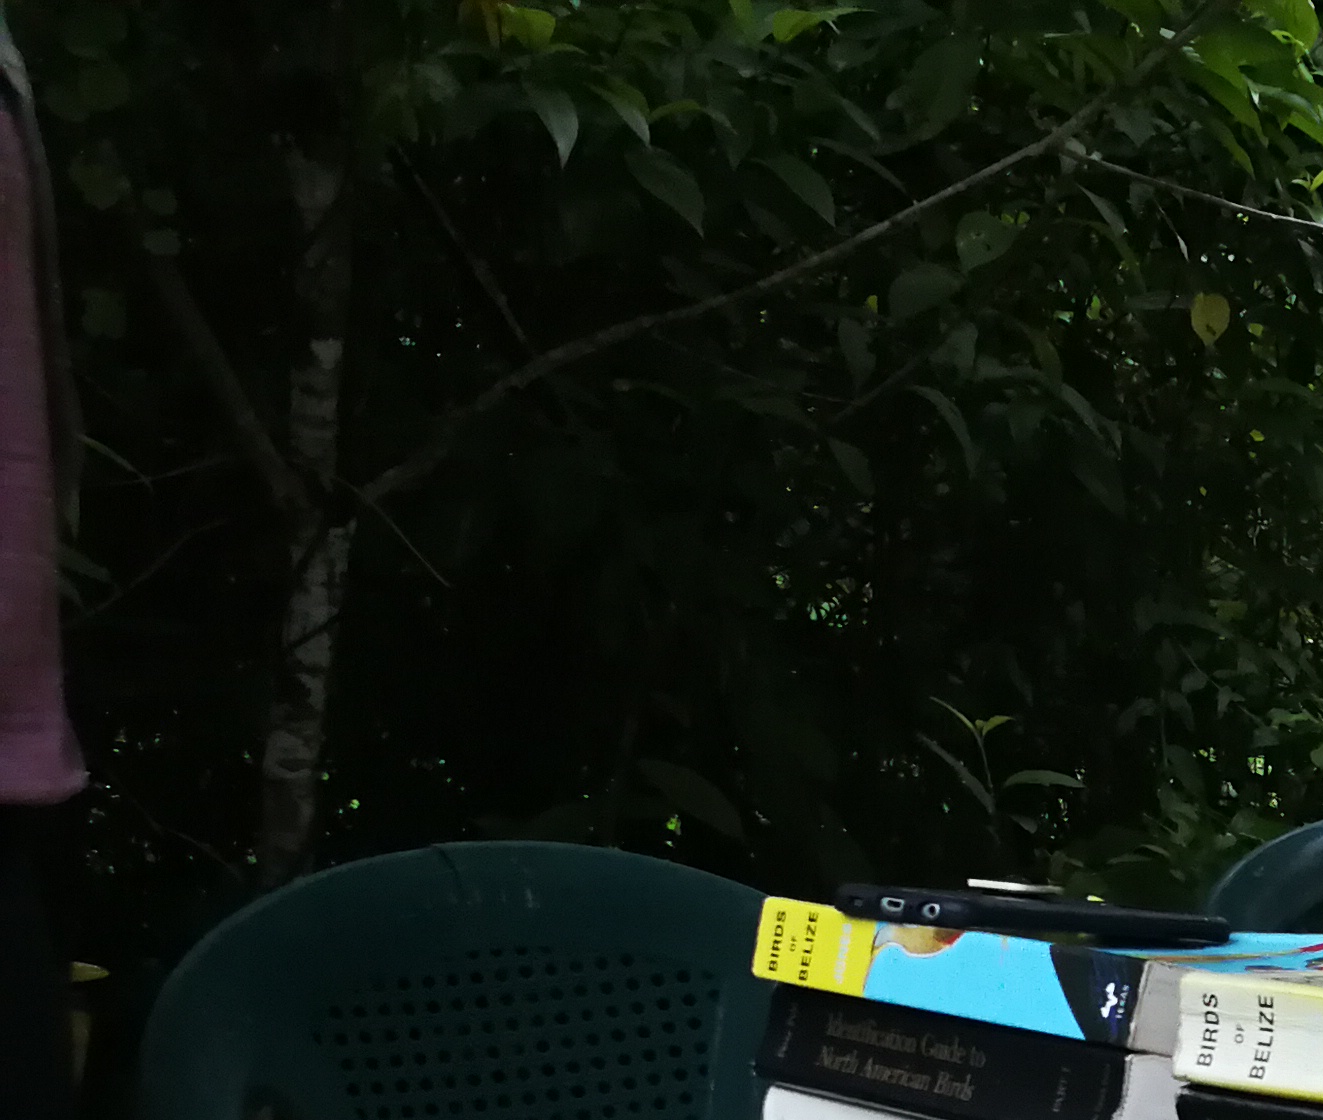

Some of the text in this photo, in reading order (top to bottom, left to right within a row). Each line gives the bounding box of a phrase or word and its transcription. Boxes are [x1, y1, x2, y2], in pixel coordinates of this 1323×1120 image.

[768, 910, 786, 971] BIRDS
[789, 936, 798, 953] OF
[799, 910, 819, 981] BELIZE
[1196, 992, 1220, 1067] BIRDS
[1234, 1023, 1245, 1044] OF
[1248, 994, 1275, 1080] BELIZE
[820, 1045, 976, 1102] North American Birds
